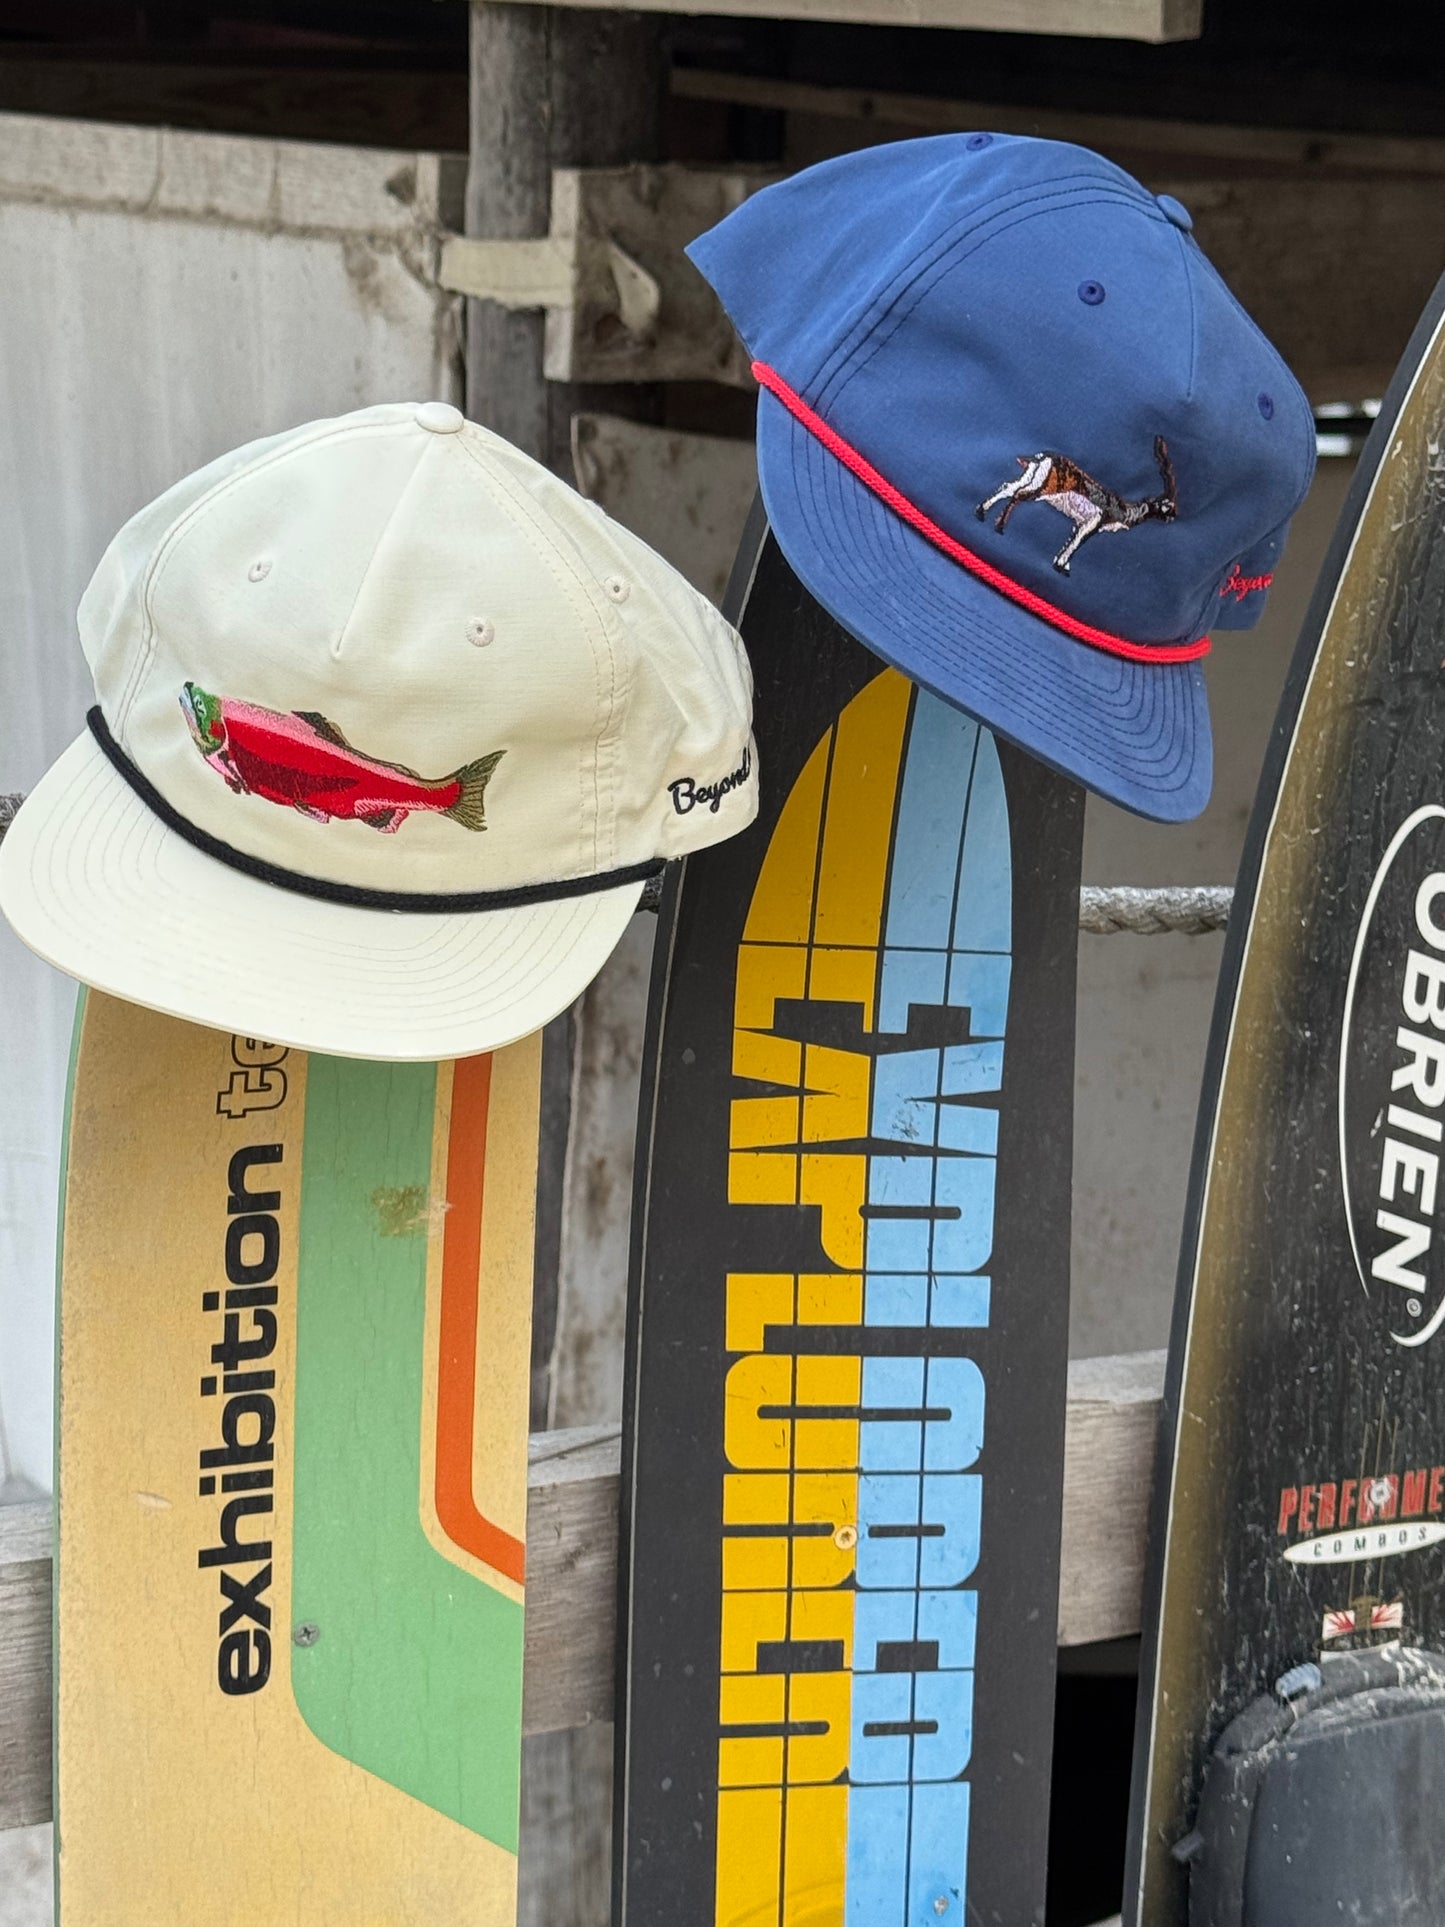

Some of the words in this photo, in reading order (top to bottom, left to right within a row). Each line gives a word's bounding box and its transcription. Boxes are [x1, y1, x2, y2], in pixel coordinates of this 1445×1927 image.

[199, 1143, 285, 1695] exhibition
[718, 943, 1013, 1786] EXPLORER
[1313, 1526, 1428, 1558] COMBOS
